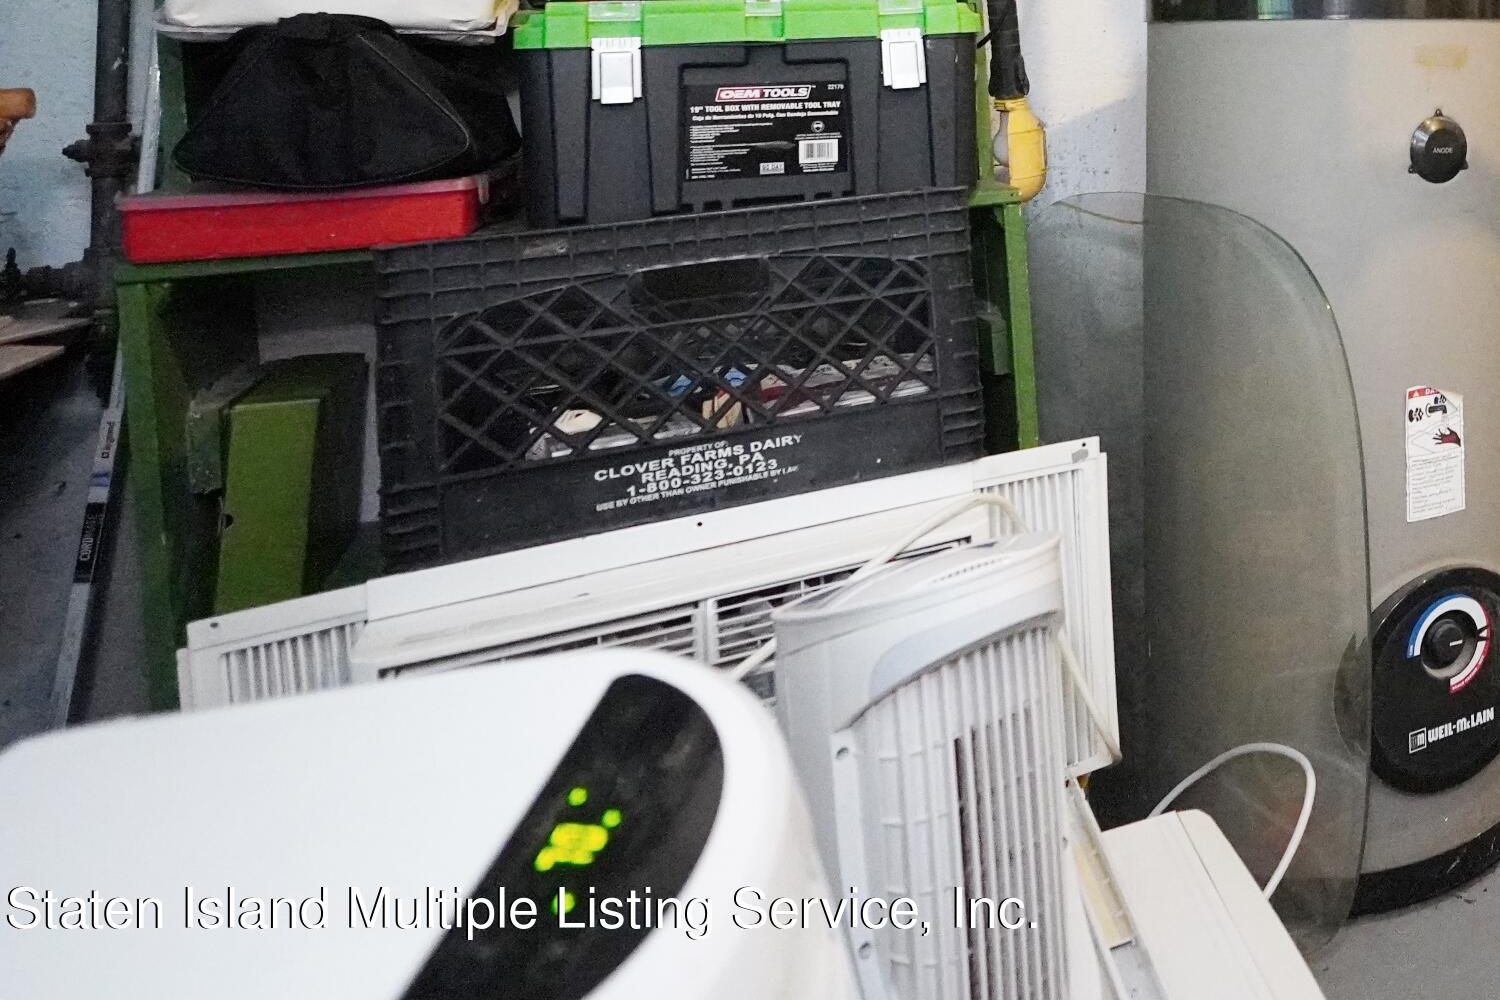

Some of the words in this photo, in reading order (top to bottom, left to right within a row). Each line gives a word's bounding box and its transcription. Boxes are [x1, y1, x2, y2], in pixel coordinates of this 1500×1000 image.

[705, 105, 723, 113] TOOL
[725, 104, 740, 112] BOX
[741, 103, 760, 111] WITH
[761, 101, 803, 111] REMOVABLE
[804, 100, 822, 109] TOOL
[823, 100, 841, 108] TRAY
[720, 88, 761, 99] OEM
[762, 87, 809, 98] TOOLS
[594, 457, 675, 481] CLOVER
[680, 444, 746, 465] FARMS
[750, 434, 802, 452] DAIRY
[668, 443, 713, 457] PROPERTY
[626, 458, 779, 497] 1-800-323-0123
[641, 459, 734, 484] READING,
[738, 451, 764, 465] PA
[596, 501, 616, 512] USE
[616, 499, 629, 509] BY
[629, 492, 660, 505] OTHER
[661, 487, 684, 499] THAN
[685, 481, 717, 494] OWNER
[770, 467, 782, 477] BY
